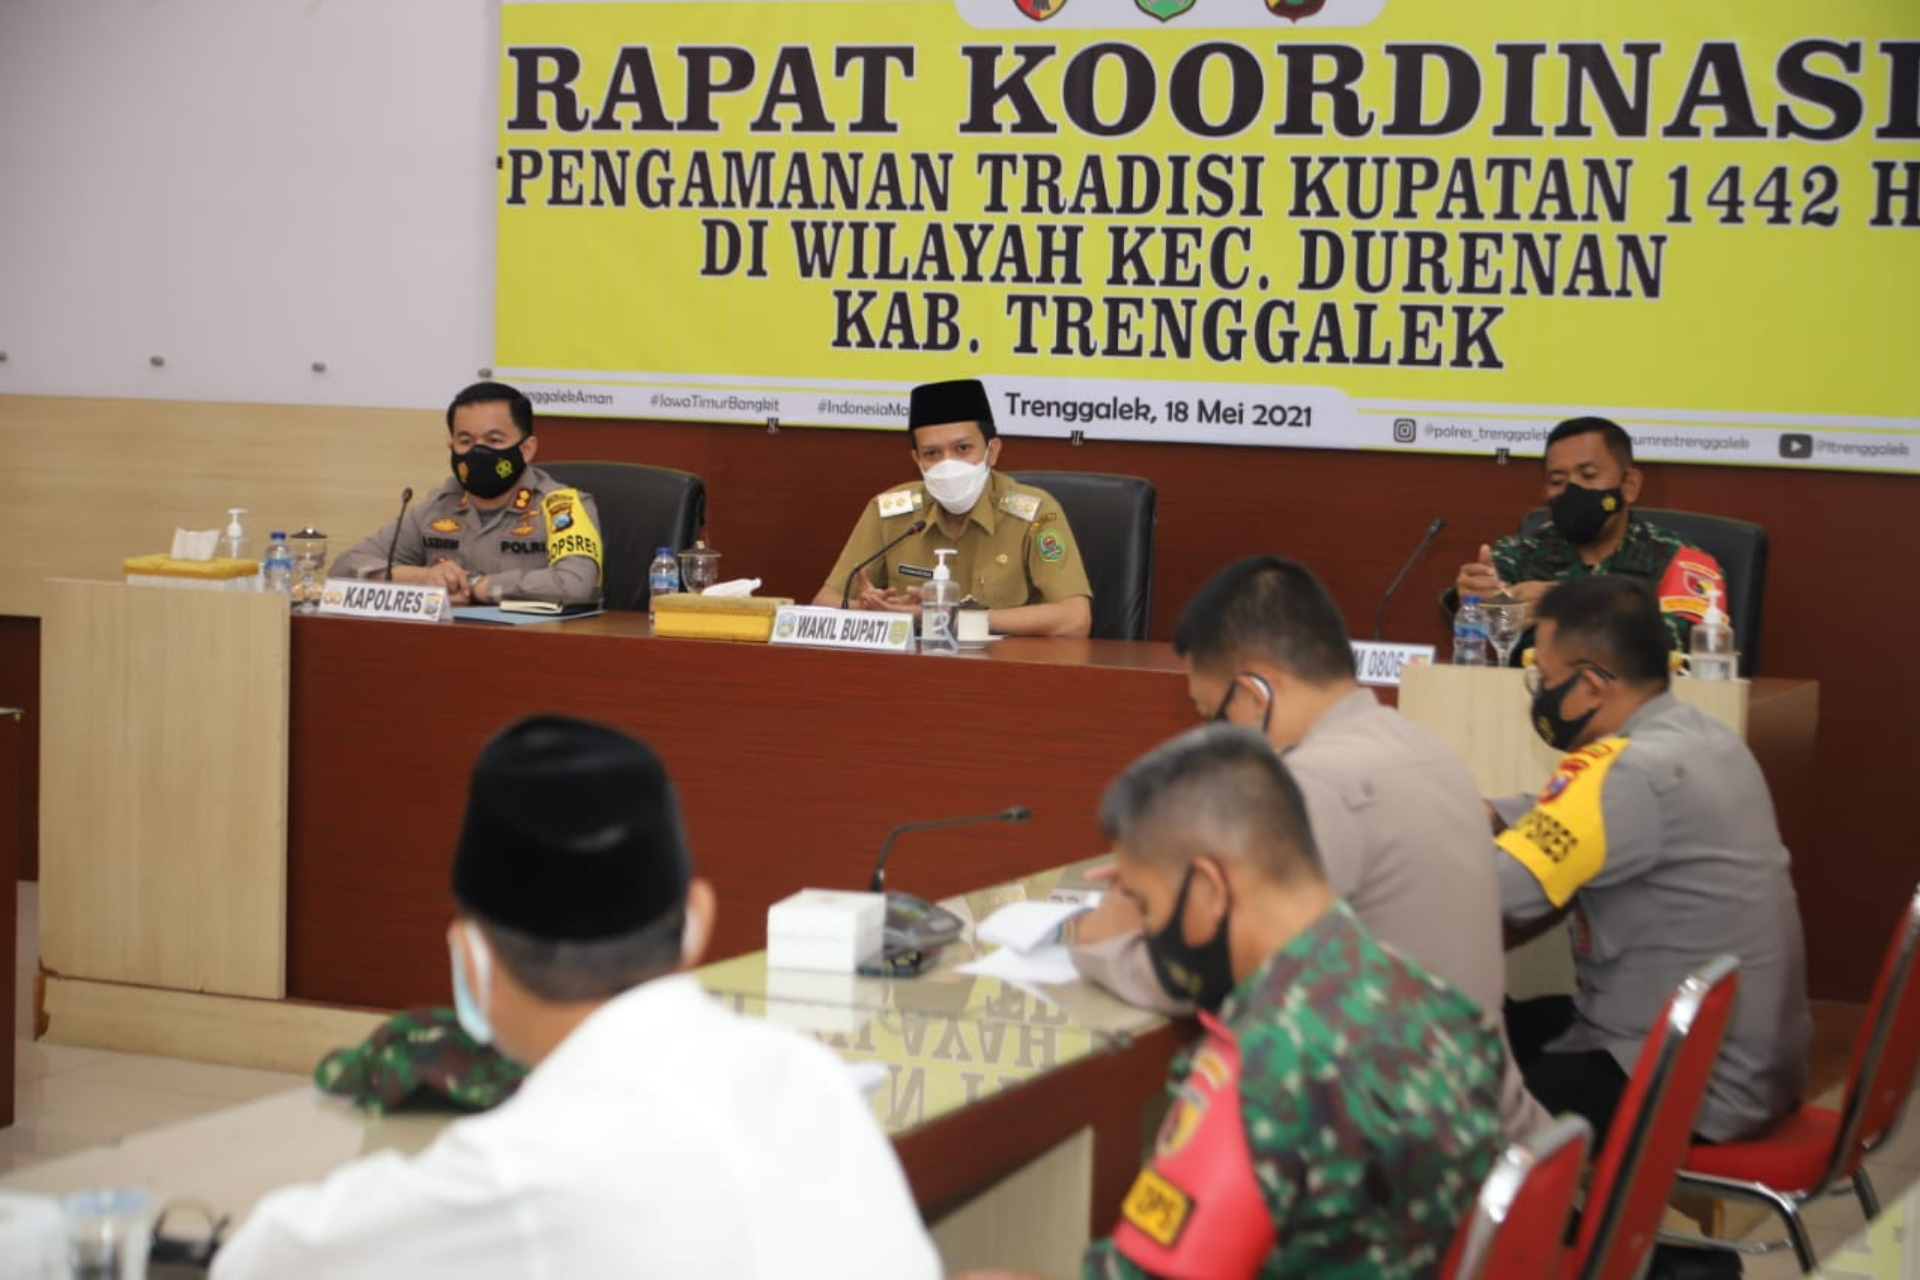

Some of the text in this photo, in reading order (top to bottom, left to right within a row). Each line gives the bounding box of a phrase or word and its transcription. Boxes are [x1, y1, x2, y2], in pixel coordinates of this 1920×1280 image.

[508, 40, 1920, 140] RAPAT KOORDINASI
[507, 148, 1920, 227] PENGAMANAN TRADISI KUPATAN 1442 H
[701, 220, 1668, 298] DI WILAYAH KEC. DURENAN
[832, 290, 1504, 369] KAB. TRENGGALEK
[651, 393, 780, 413] #JawaTimurBangkit
[1005, 392, 1312, 427] Trenggalek, 18 Mei 2021
[342, 586, 424, 614] KAPOLRES
[797, 615, 888, 644] WAKIL BUPATI
[1368, 650, 1404, 678] 0806
